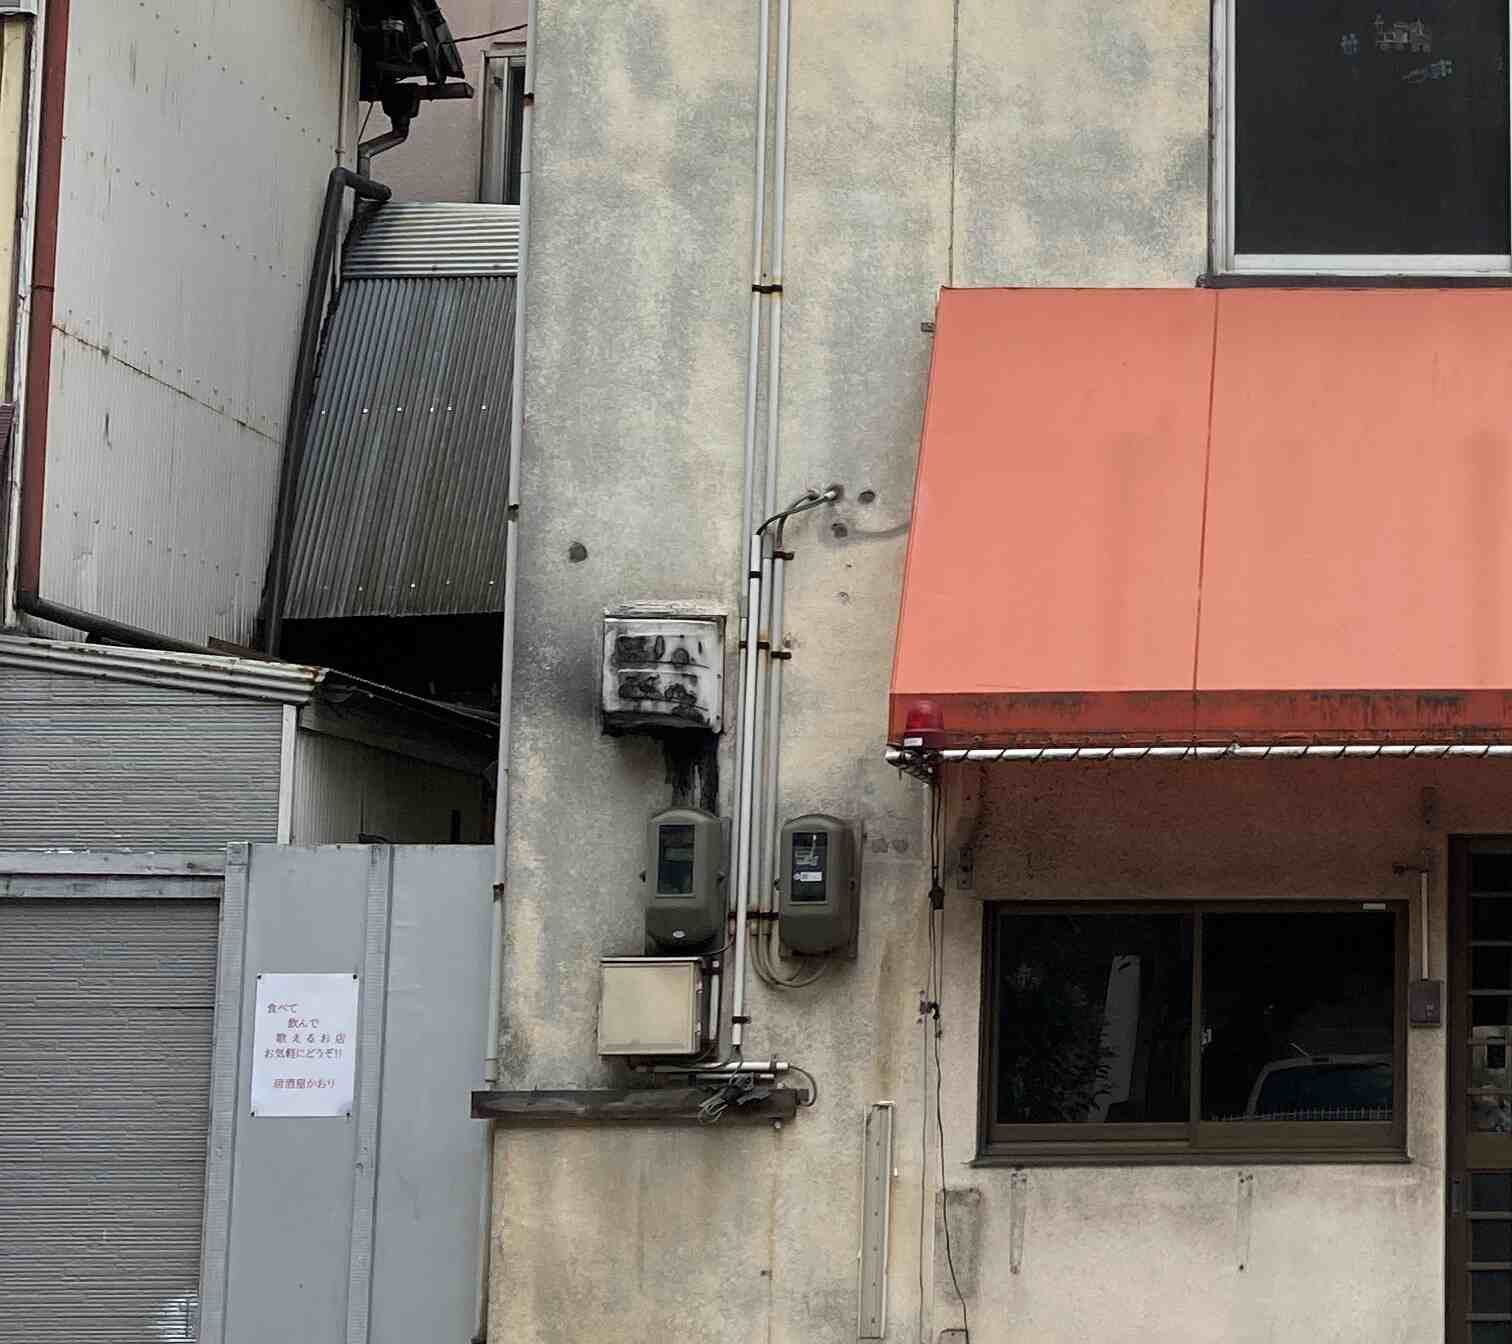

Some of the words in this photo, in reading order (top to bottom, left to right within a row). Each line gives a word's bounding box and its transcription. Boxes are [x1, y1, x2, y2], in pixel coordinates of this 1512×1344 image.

[267, 1003, 298, 1014] 食べて
[287, 1018, 320, 1029] 飲んで
